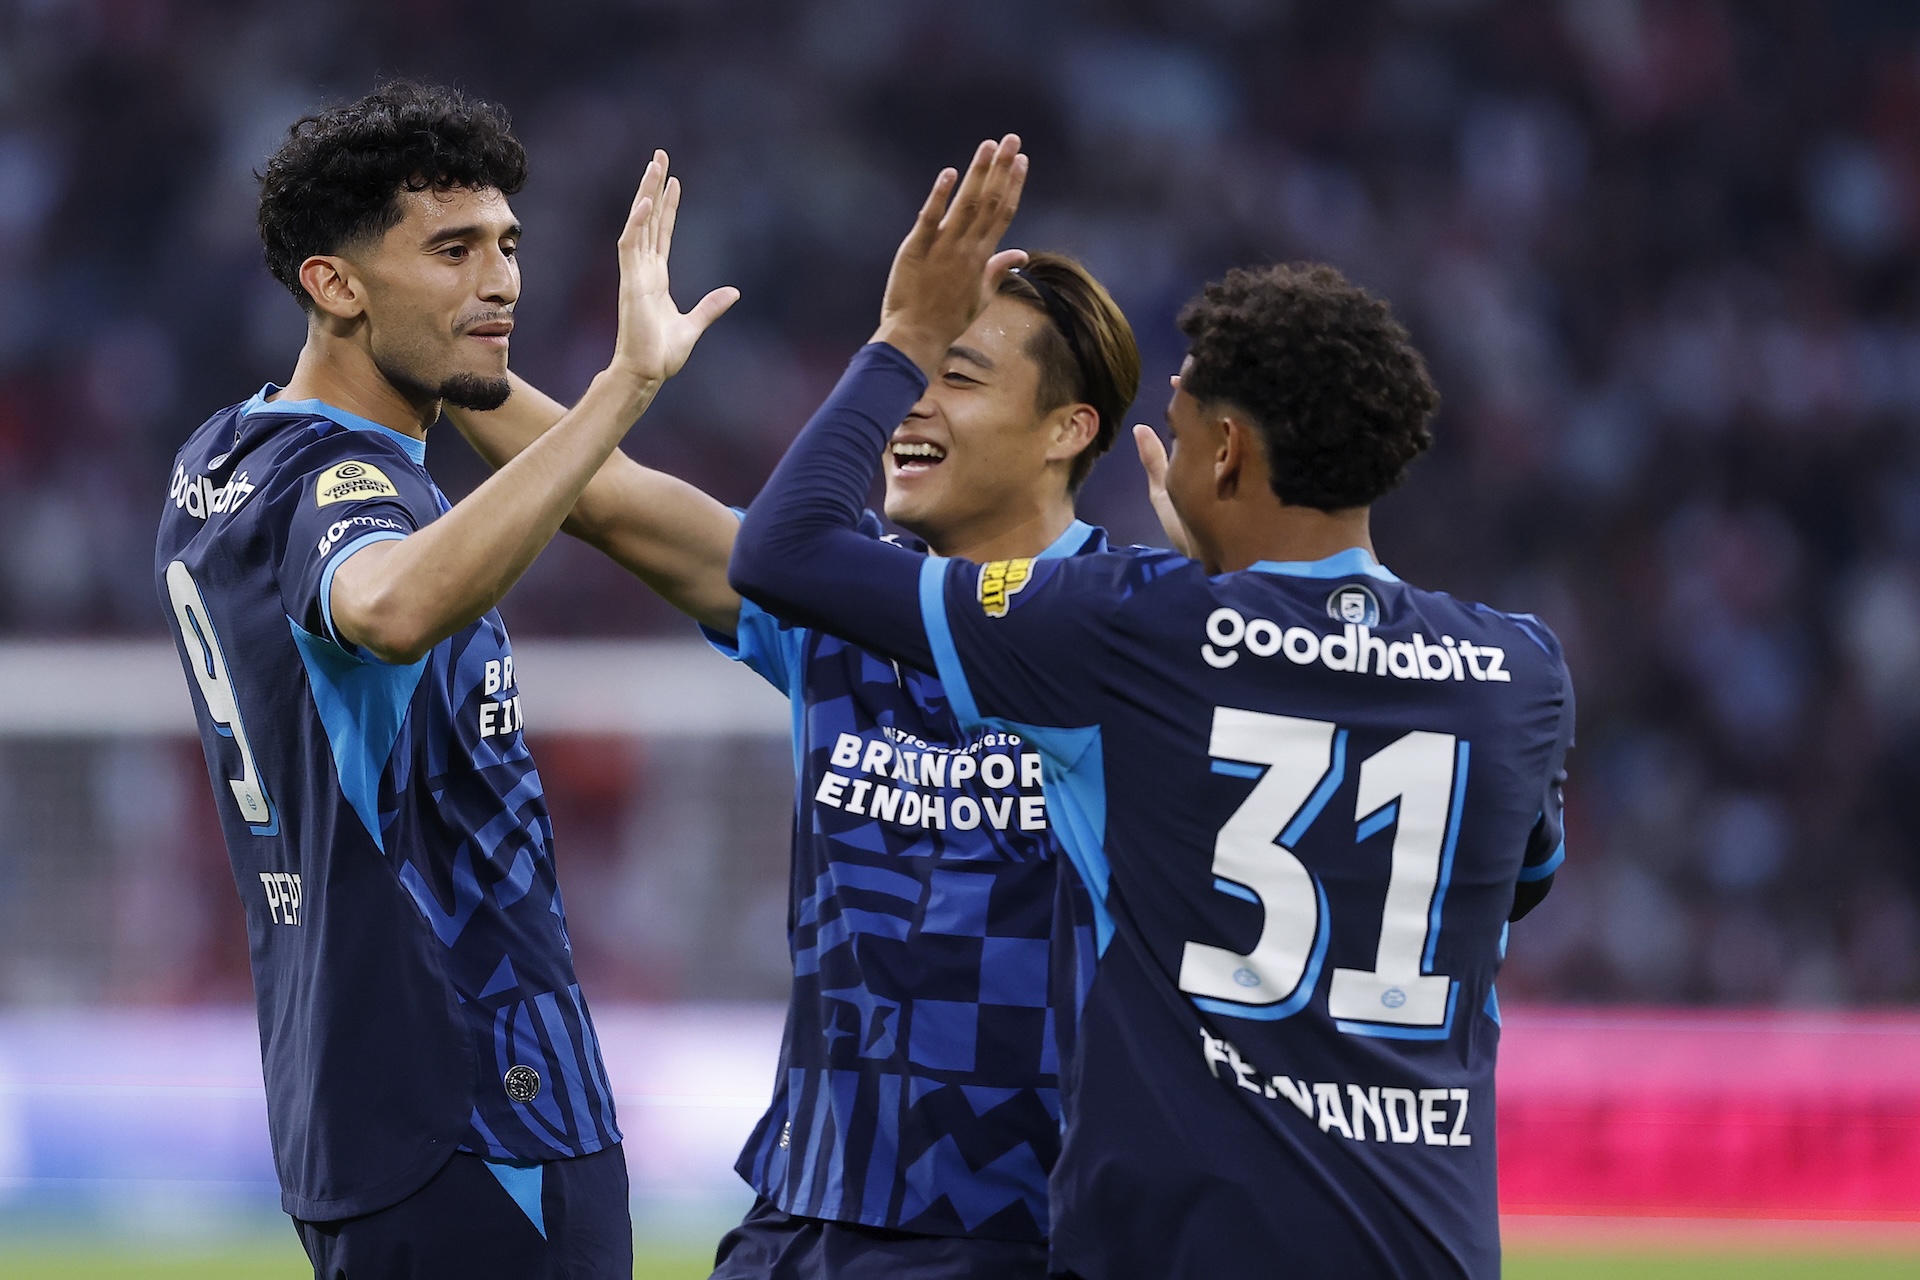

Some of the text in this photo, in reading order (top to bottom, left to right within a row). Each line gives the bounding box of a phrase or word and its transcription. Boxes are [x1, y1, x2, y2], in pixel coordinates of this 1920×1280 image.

[169, 459, 256, 520] oodhbitz
[324, 480, 391, 497] VRIENDEN
[1200, 607, 1511, 682] goodhabitz
[166, 561, 270, 823] 9
[484, 655, 518, 696] BR
[830, 732, 1044, 789] BRAINPOR
[814, 771, 1047, 831] EINDHOVE
[1178, 705, 1457, 1027] 31
[1199, 1026, 1472, 1148] FENANDEZ
